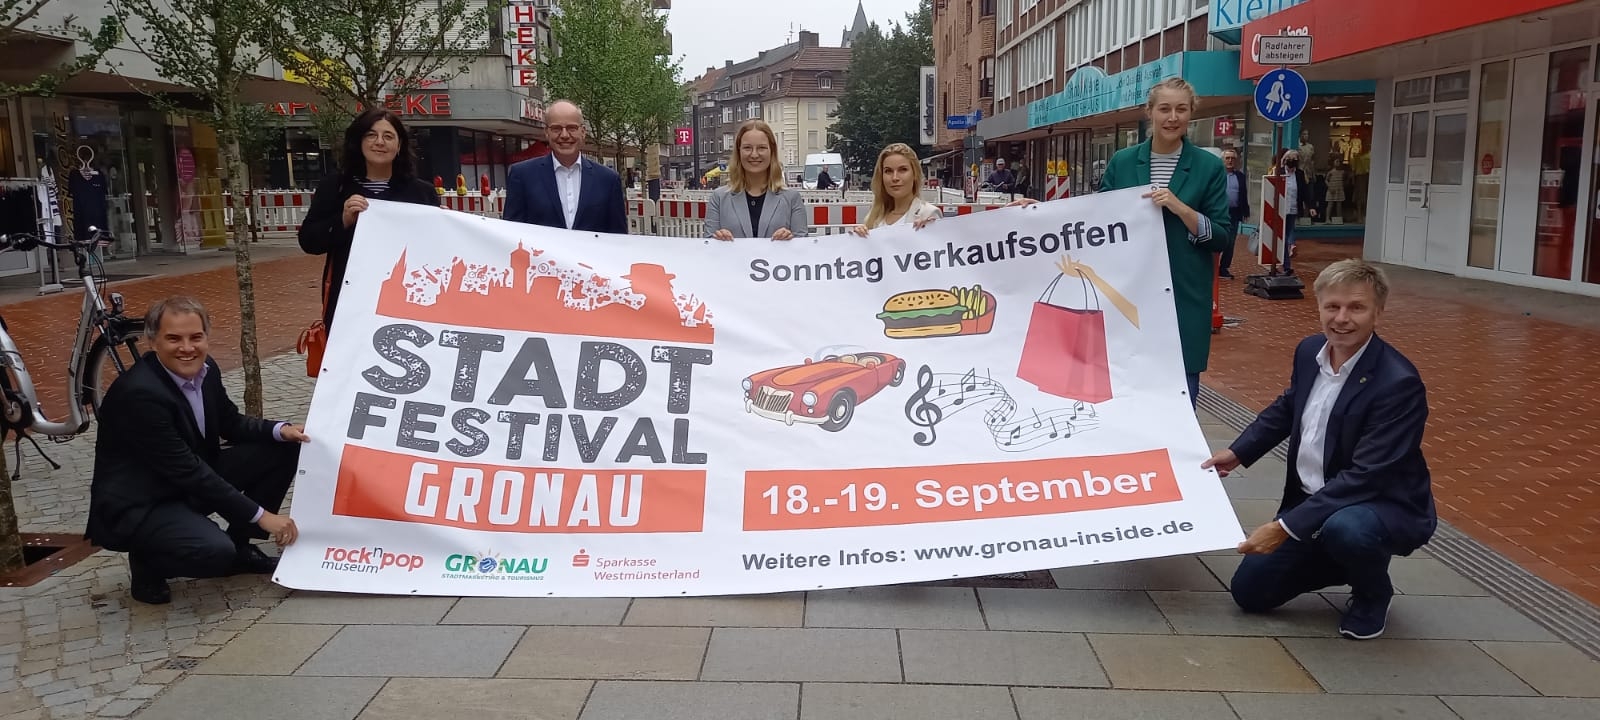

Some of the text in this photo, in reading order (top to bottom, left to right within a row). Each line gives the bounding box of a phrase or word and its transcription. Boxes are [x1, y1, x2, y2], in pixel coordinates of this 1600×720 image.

[1265, 42, 1305, 50] Radfahrer
[1265, 52, 1304, 60] absteigen
[749, 221, 1129, 283] Sonntag verkaufsoffen
[361, 323, 713, 414] STADT
[346, 391, 708, 464] FESTIVAL
[404, 461, 643, 527] GRONAU
[762, 471, 1157, 515] 18.-19. September
[321, 561, 379, 573] museum
[596, 557, 657, 569] Sparkasse
[742, 520, 1195, 571] Weitere Infos: www.gronau-inside.de
[594, 569, 700, 581] Westmünsterland
